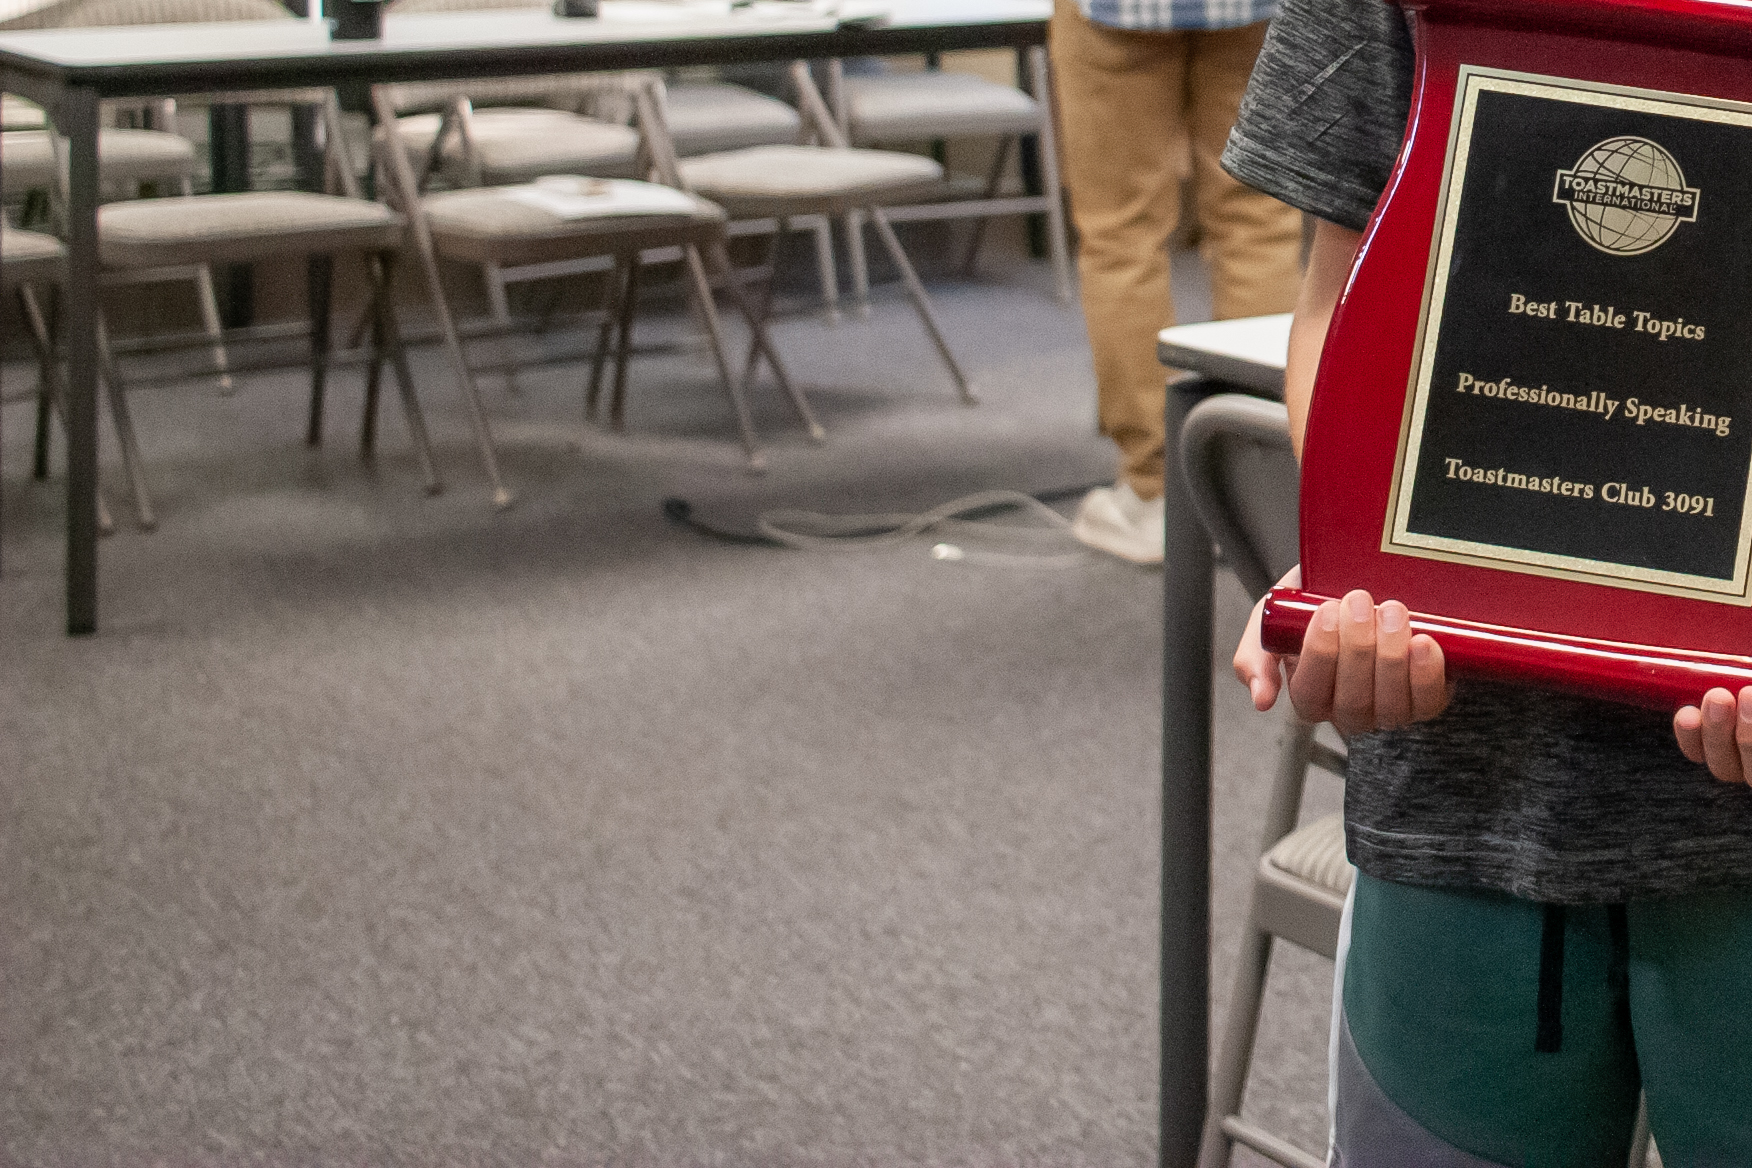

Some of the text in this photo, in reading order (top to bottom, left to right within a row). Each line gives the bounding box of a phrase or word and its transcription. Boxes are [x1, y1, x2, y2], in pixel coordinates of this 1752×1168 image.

[1563, 176, 1692, 206] TOASTMASTERS
[1574, 190, 1677, 213] INTERNATIONAL
[1508, 293, 1705, 341] Best Table Topics
[1456, 372, 1732, 437] Professionally Speaking
[1445, 457, 1715, 517] Toastmasters Club 3091
